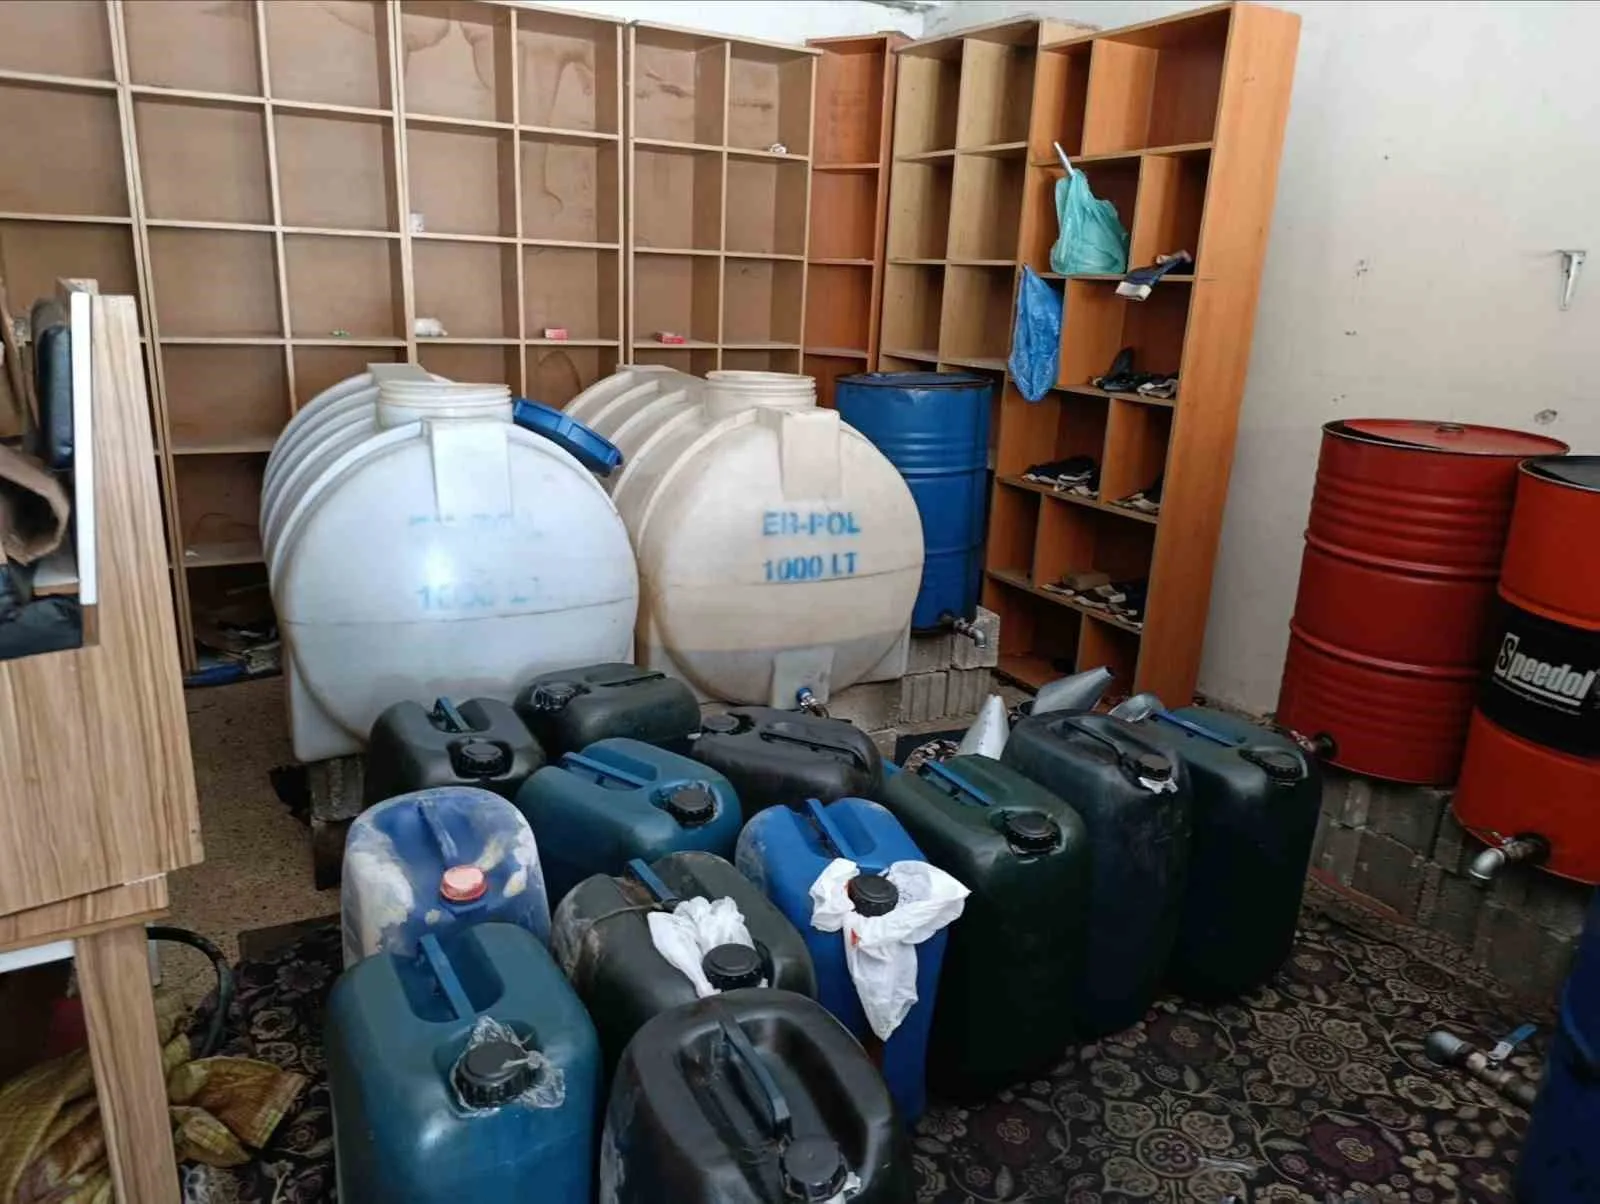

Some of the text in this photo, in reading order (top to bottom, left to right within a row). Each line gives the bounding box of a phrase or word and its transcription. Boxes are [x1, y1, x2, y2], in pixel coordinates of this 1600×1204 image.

[763, 511, 861, 536] ER-POL
[763, 555, 823, 581] 1000
[1494, 631, 1596, 699] Speedol
